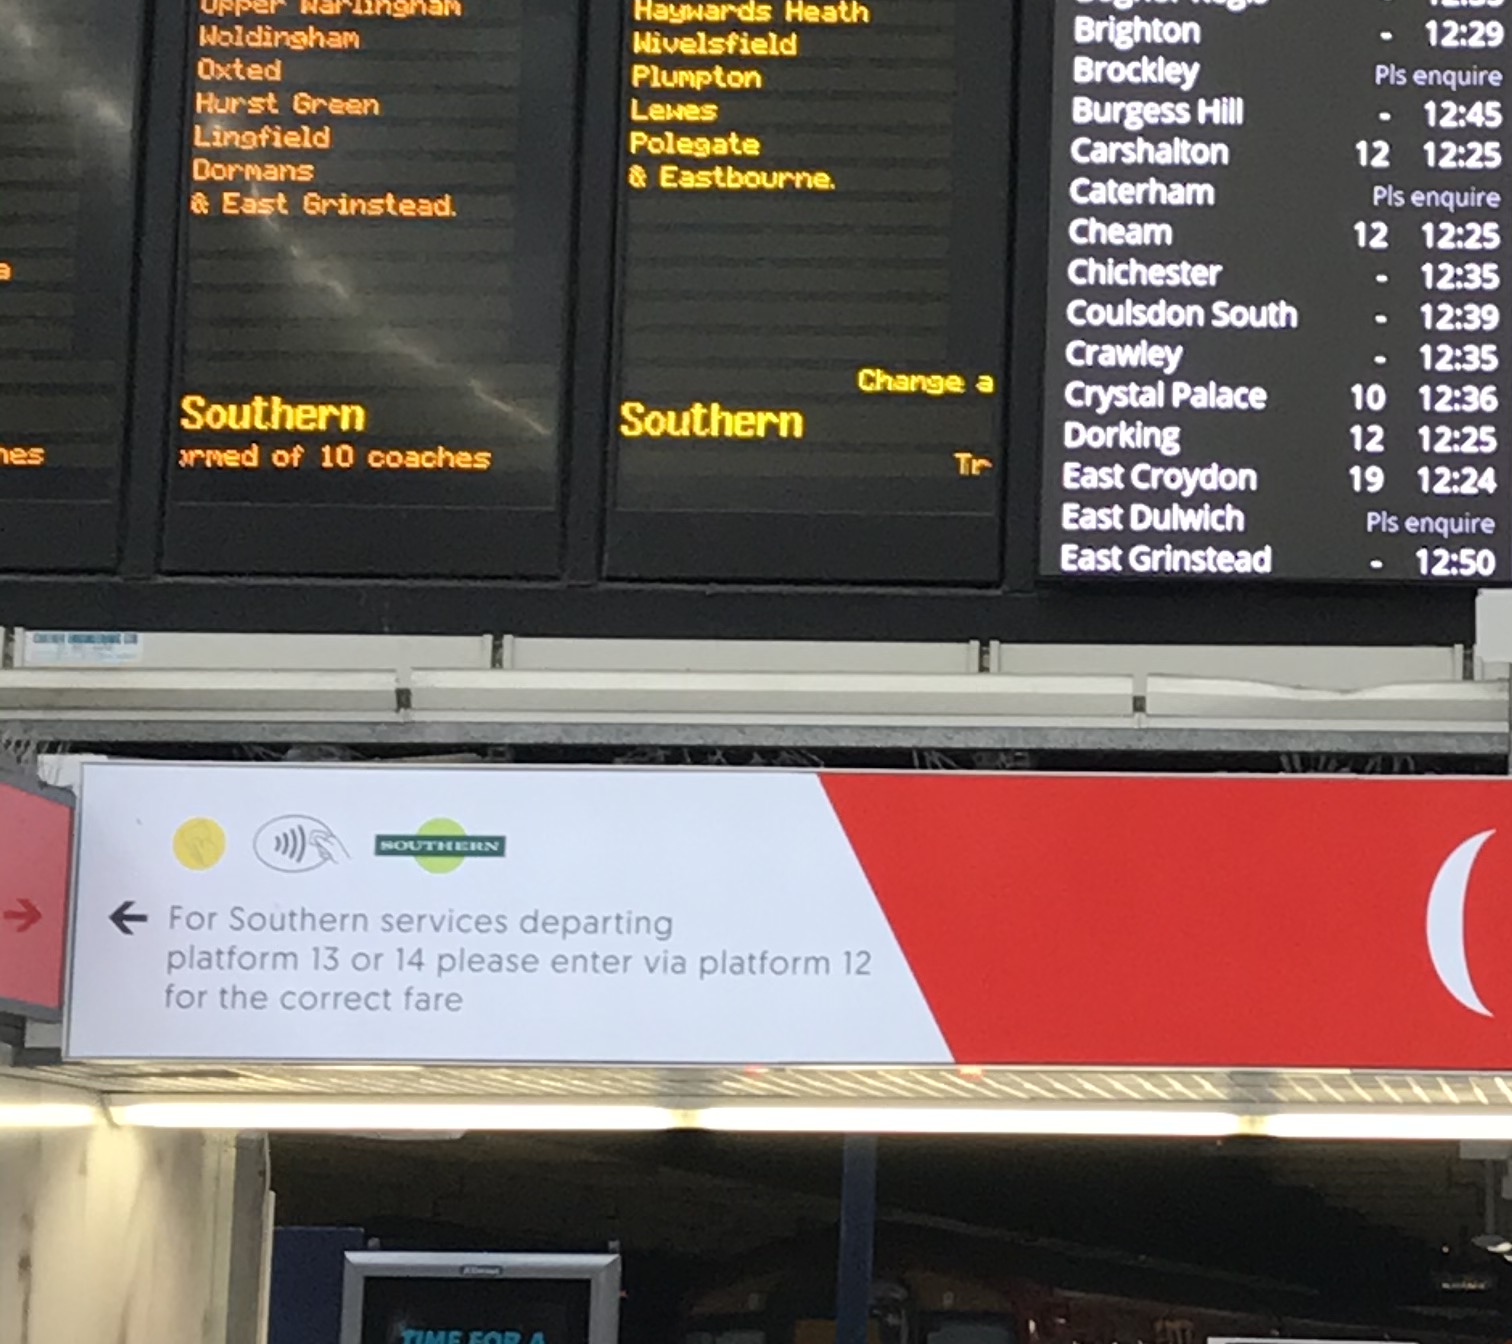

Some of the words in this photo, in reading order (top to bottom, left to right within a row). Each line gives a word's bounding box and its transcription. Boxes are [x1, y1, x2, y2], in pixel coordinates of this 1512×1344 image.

[634, 31, 797, 56] Wivelsfield
[632, 65, 761, 90] Plumpton
[194, 124, 330, 150] Lingfield
[630, 131, 760, 158] Polegate
[1071, 137, 1228, 165] Carshalton
[1424, 141, 1502, 169] 12:25
[181, 395, 365, 431] Southern
[272, 445, 304, 467] of
[322, 444, 353, 467] 10
[368, 446, 491, 469] coaches
[380, 839, 499, 851] SOUTHERN
[170, 905, 217, 930] For
[230, 906, 367, 932] Southern
[381, 909, 507, 933] services
[520, 910, 672, 941] departing
[167, 945, 297, 975] platform
[313, 947, 339, 971] 13
[352, 952, 383, 971] or
[397, 948, 424, 971] 14
[438, 948, 539, 977] please
[551, 952, 632, 974] enter
[644, 950, 686, 974] via
[700, 950, 829, 980] platform
[845, 950, 871, 975] 12
[165, 983, 207, 1009] for
[220, 985, 267, 1009] the
[280, 989, 391, 1011] correct
[405, 986, 463, 1011] fare
